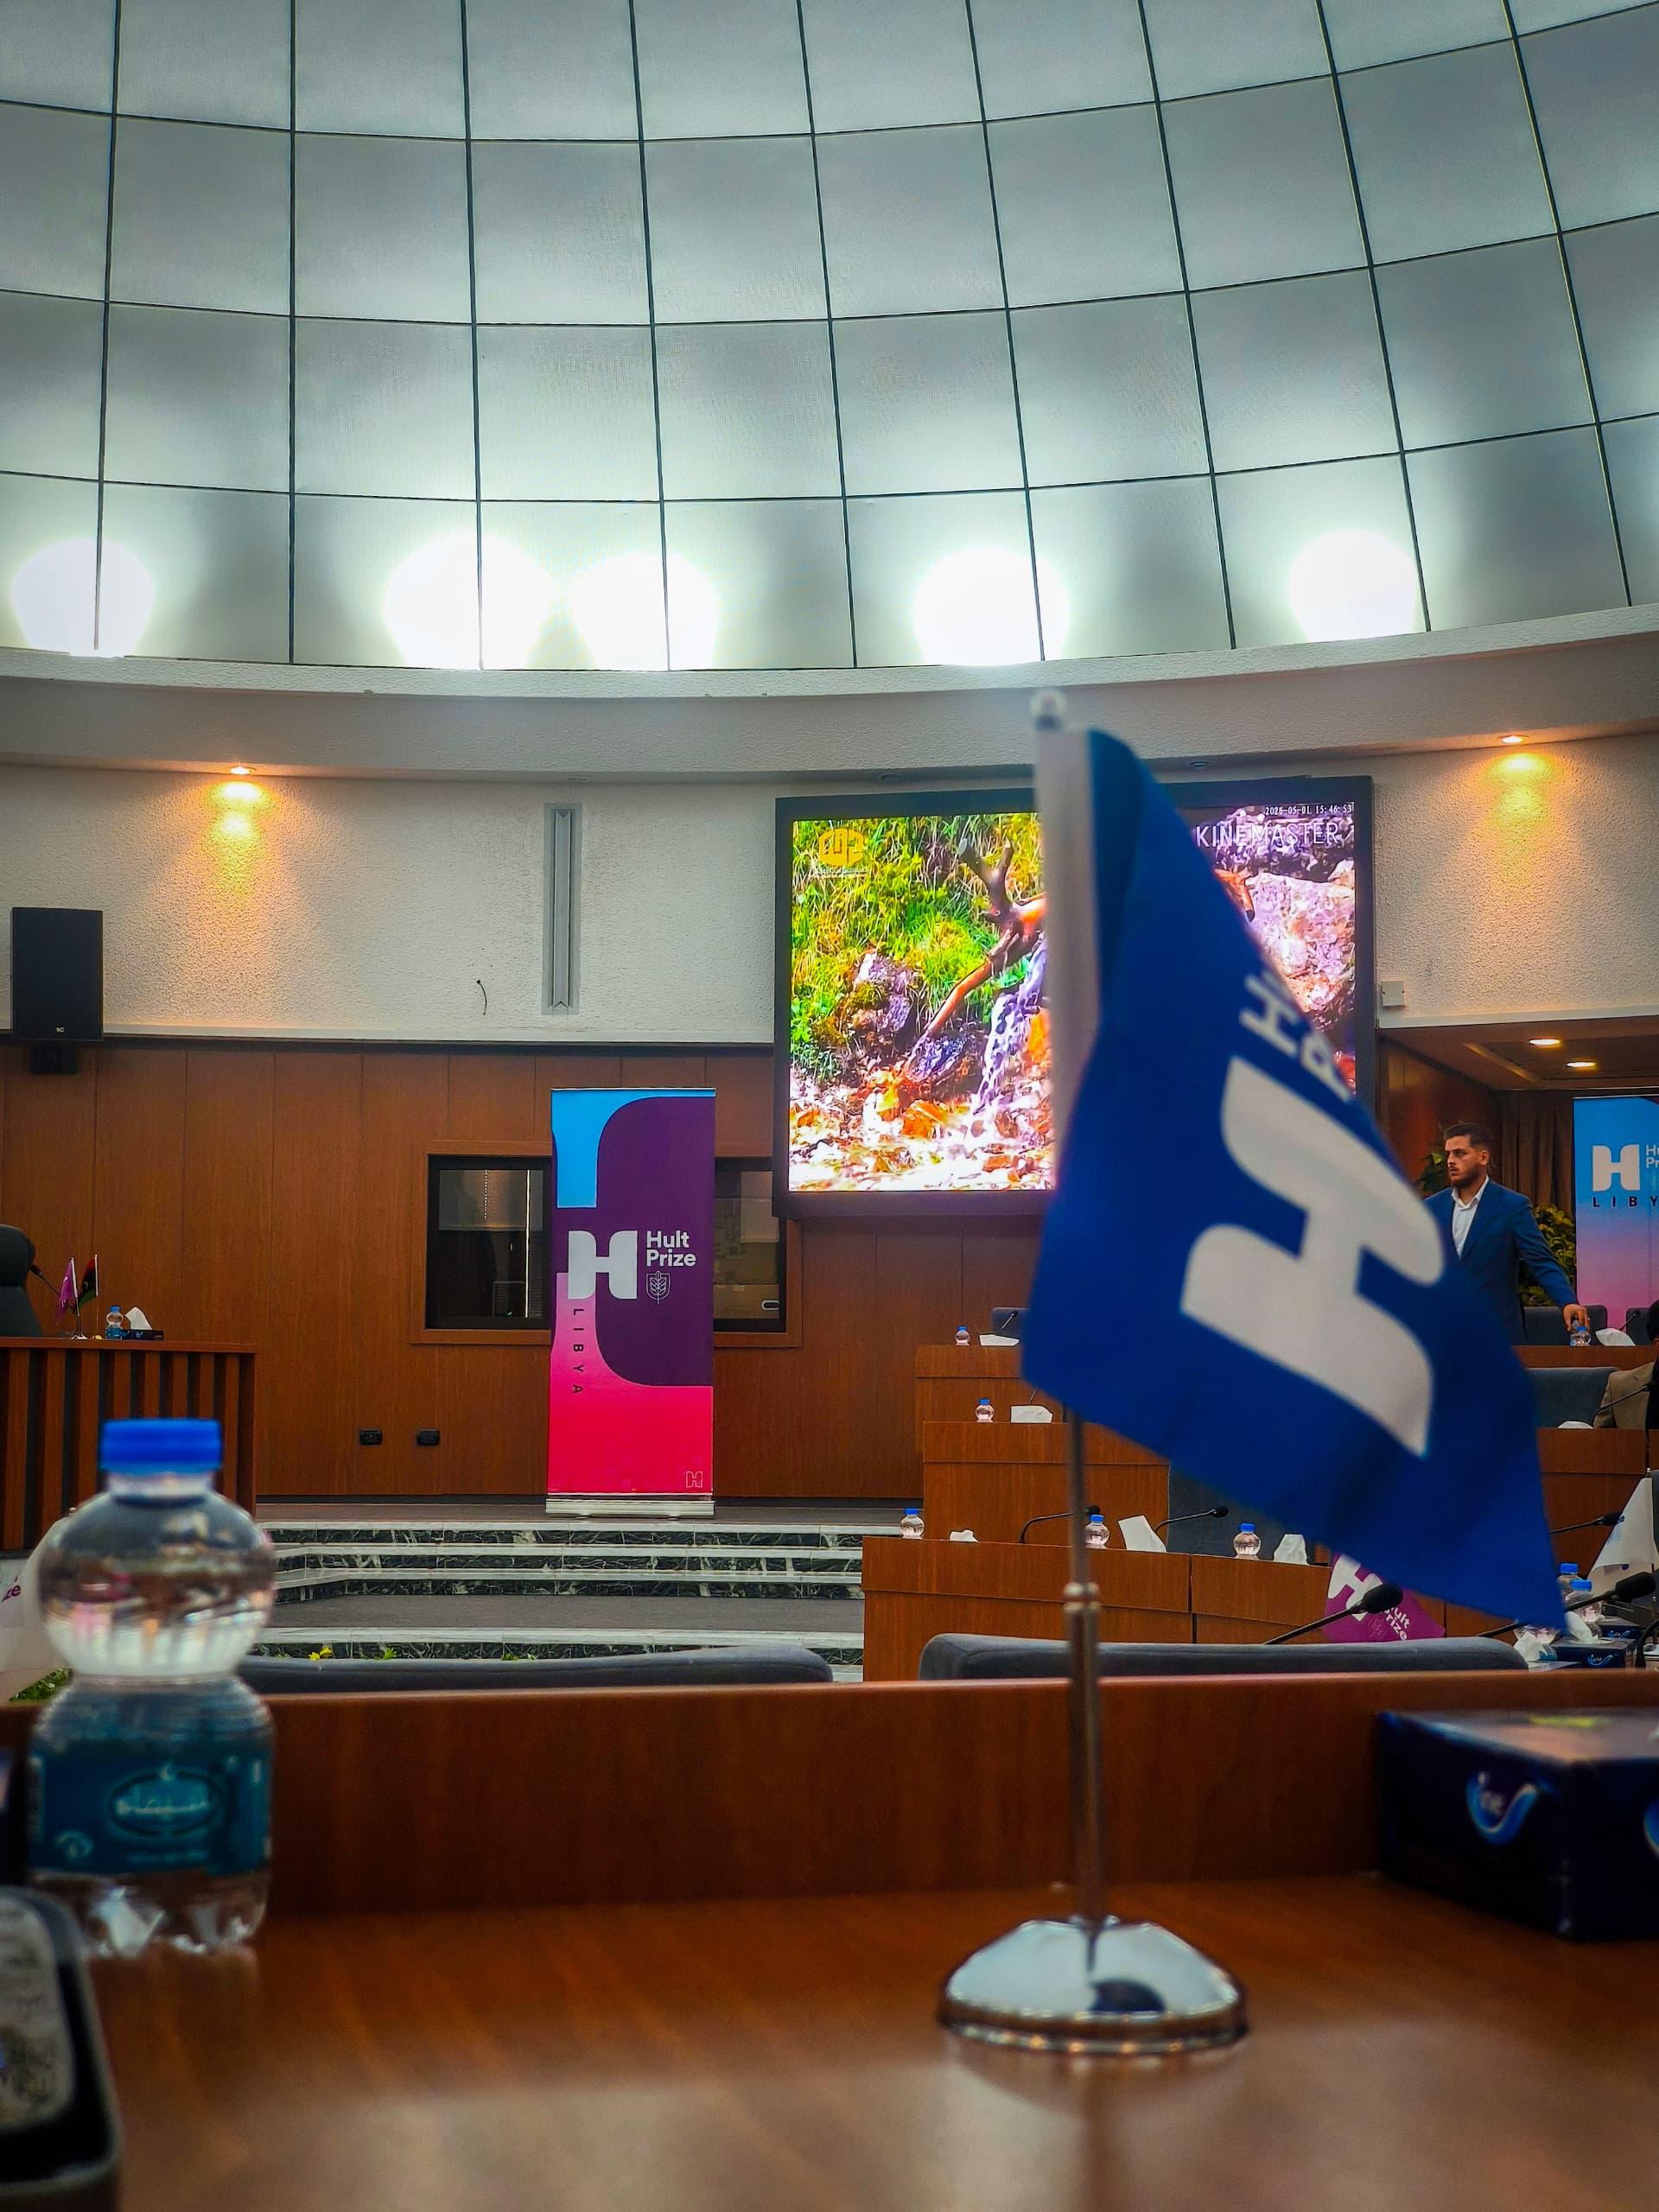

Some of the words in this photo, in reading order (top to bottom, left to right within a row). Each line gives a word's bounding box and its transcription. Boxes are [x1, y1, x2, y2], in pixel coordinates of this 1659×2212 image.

[1196, 822, 1338, 847] KINEMASTER
[646, 1230, 690, 1249] Hult
[646, 1249, 696, 1267] Prize
[572, 1307, 584, 1394] LIBYA
